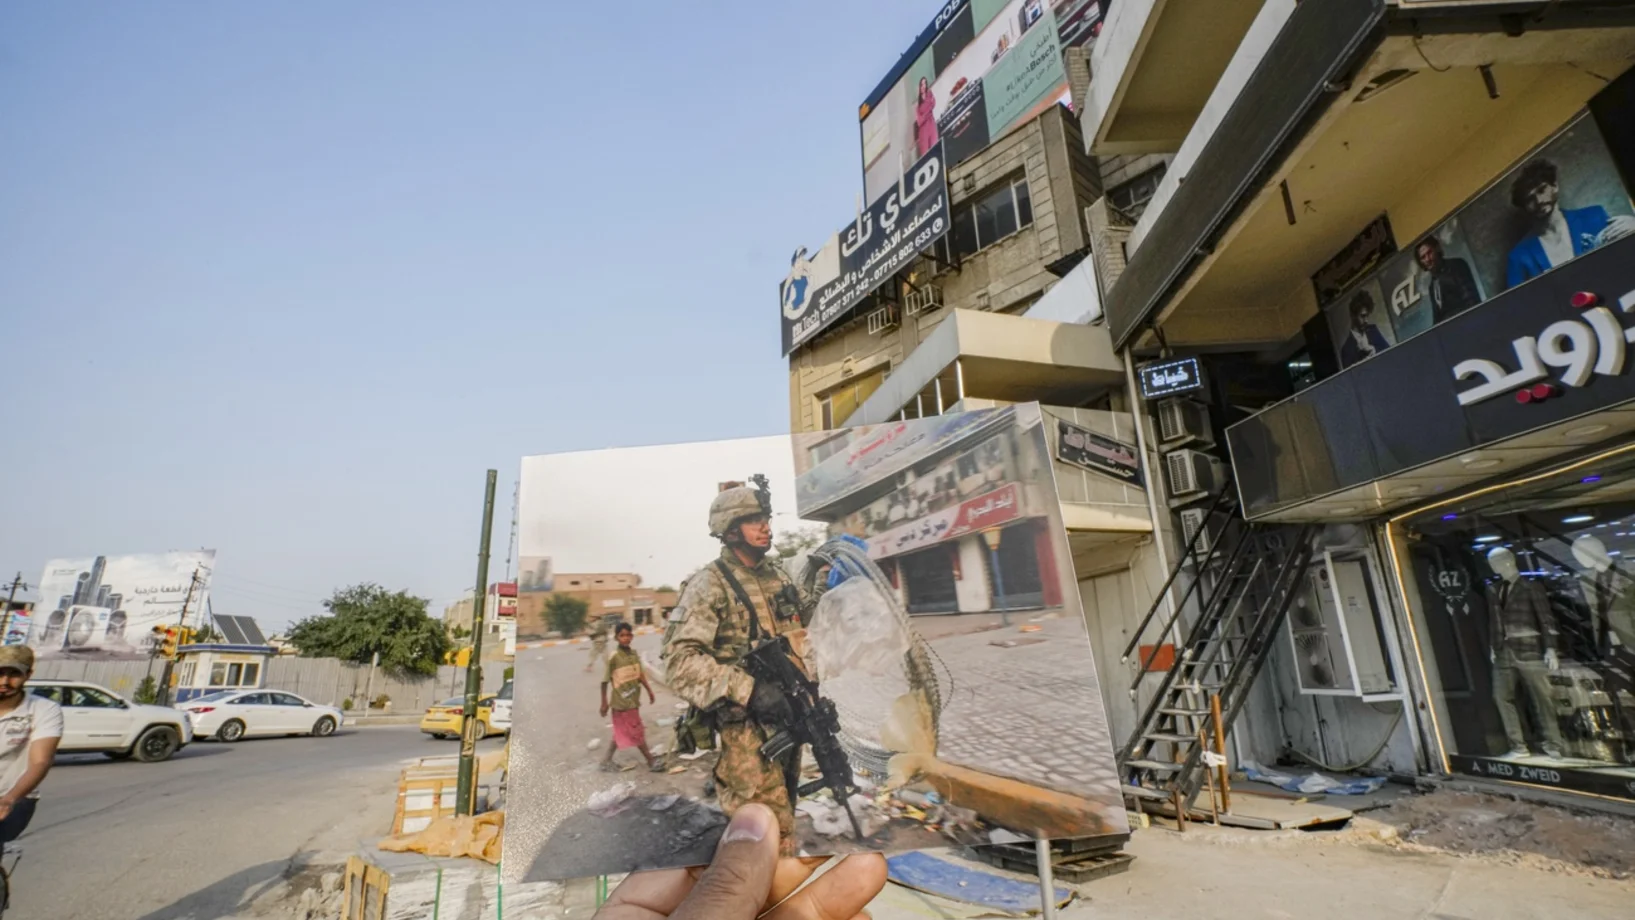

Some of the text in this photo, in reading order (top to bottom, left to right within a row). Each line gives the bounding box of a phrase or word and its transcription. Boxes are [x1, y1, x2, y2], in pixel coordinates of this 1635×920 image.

[879, 148, 940, 235] هاي
[901, 194, 943, 239] لمصاعد
[873, 254, 898, 280] 07715
[898, 241, 914, 260] 802
[914, 227, 932, 247] 633
[1391, 274, 1421, 316] AZ
[1452, 291, 1626, 406] زويد
[1151, 366, 1189, 387] خياط
[1438, 570, 1462, 588] AZ
[1519, 766, 1561, 783] ZWEID
